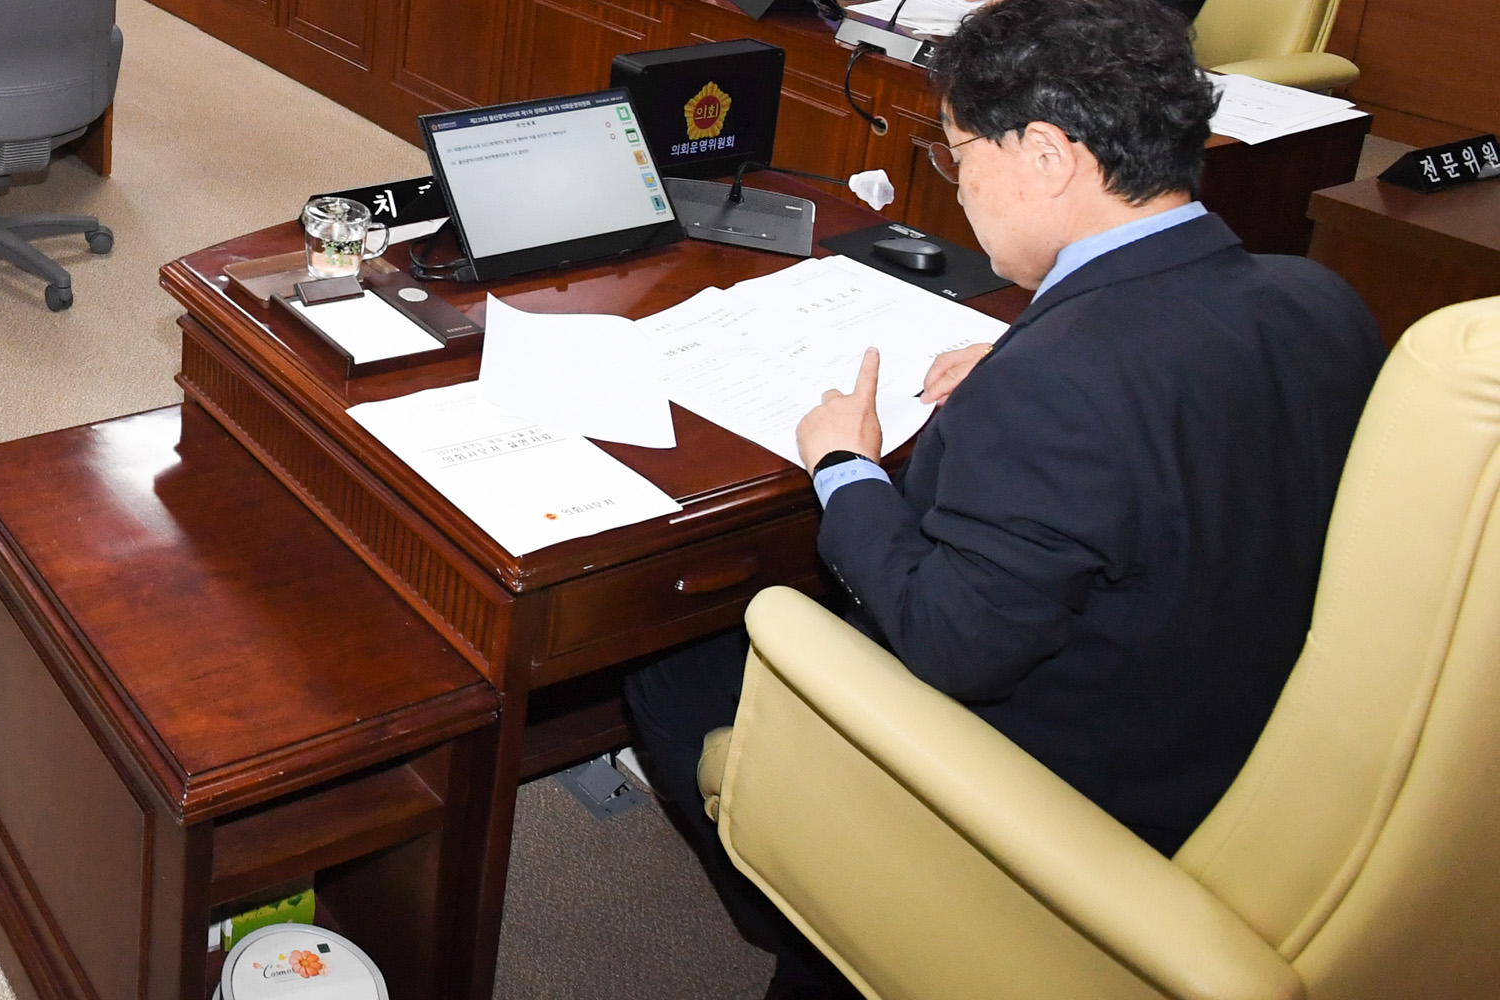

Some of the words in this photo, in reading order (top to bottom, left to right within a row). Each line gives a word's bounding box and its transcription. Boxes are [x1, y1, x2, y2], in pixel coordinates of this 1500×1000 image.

[695, 103, 719, 120] 의회
[670, 135, 735, 156] 의회운영위원회
[1420, 141, 1500, 182] 전문위원
